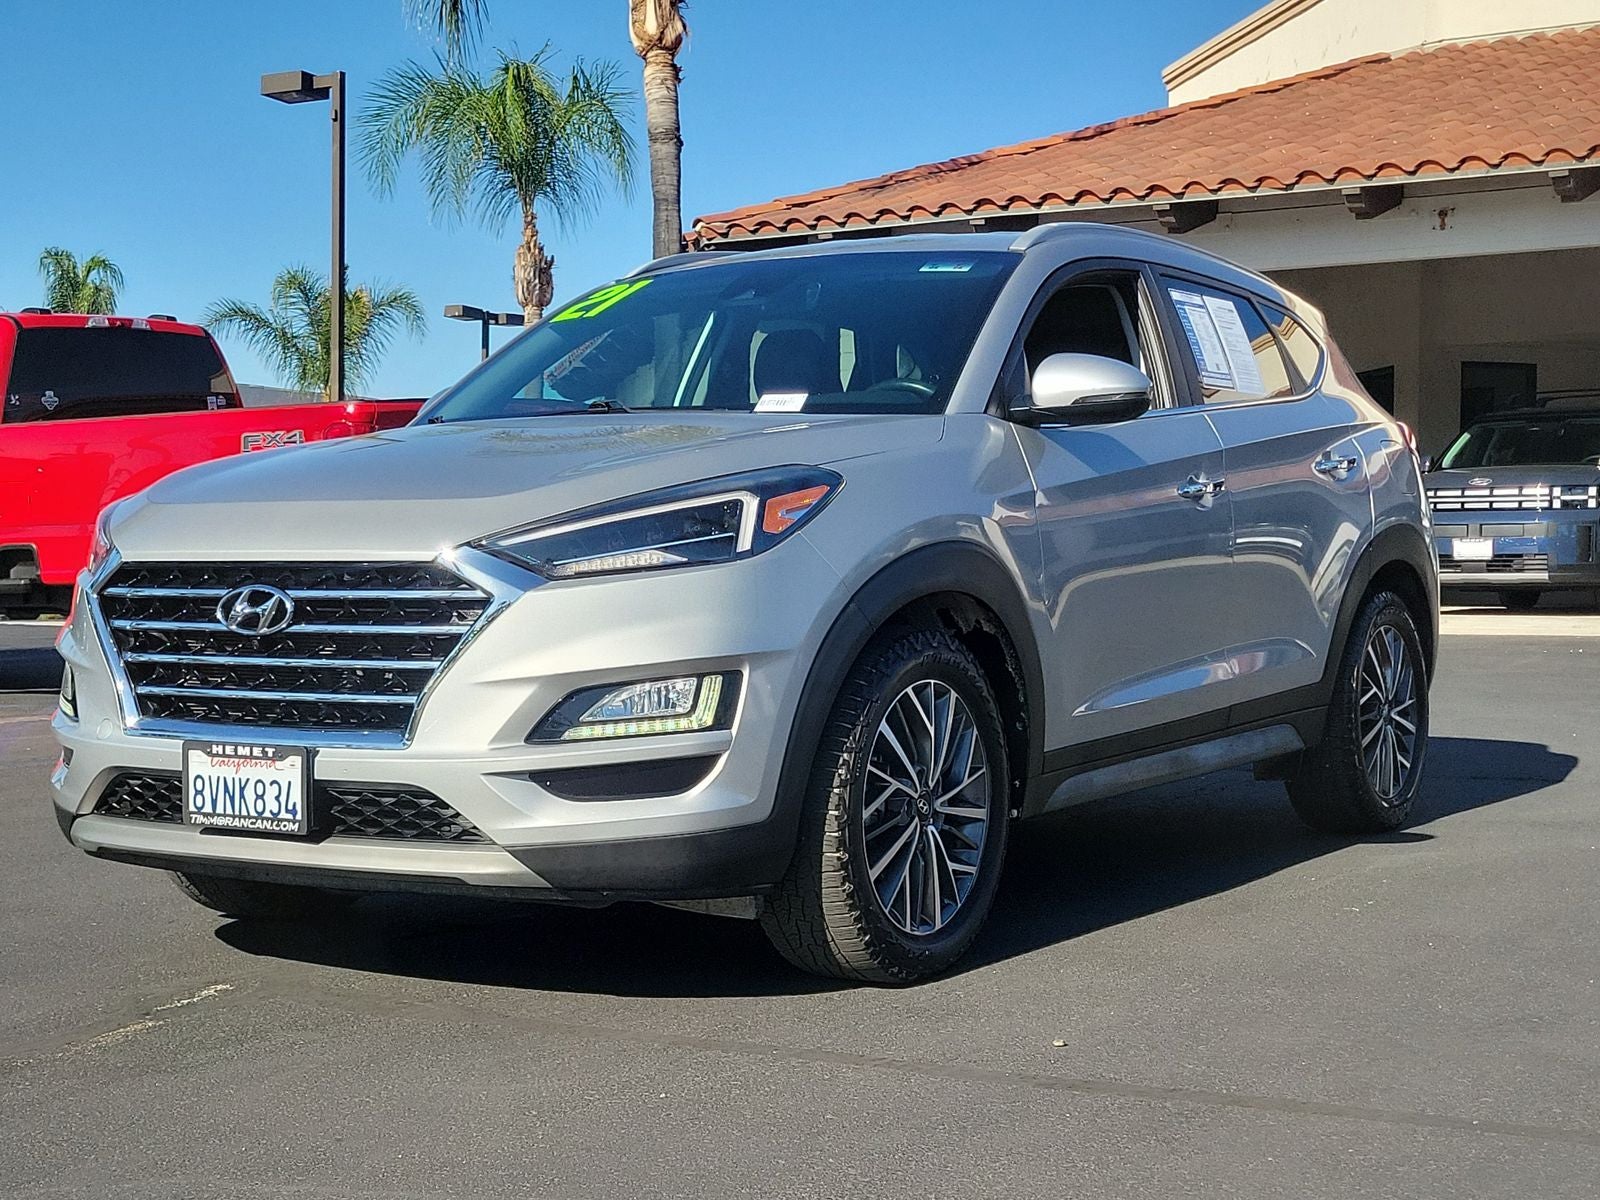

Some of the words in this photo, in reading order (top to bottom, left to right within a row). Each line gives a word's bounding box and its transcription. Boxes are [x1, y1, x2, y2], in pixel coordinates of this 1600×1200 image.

[241, 430, 304, 453] FX4
[211, 744, 276, 757] HEMET
[193, 774, 298, 820] 8VNK834
